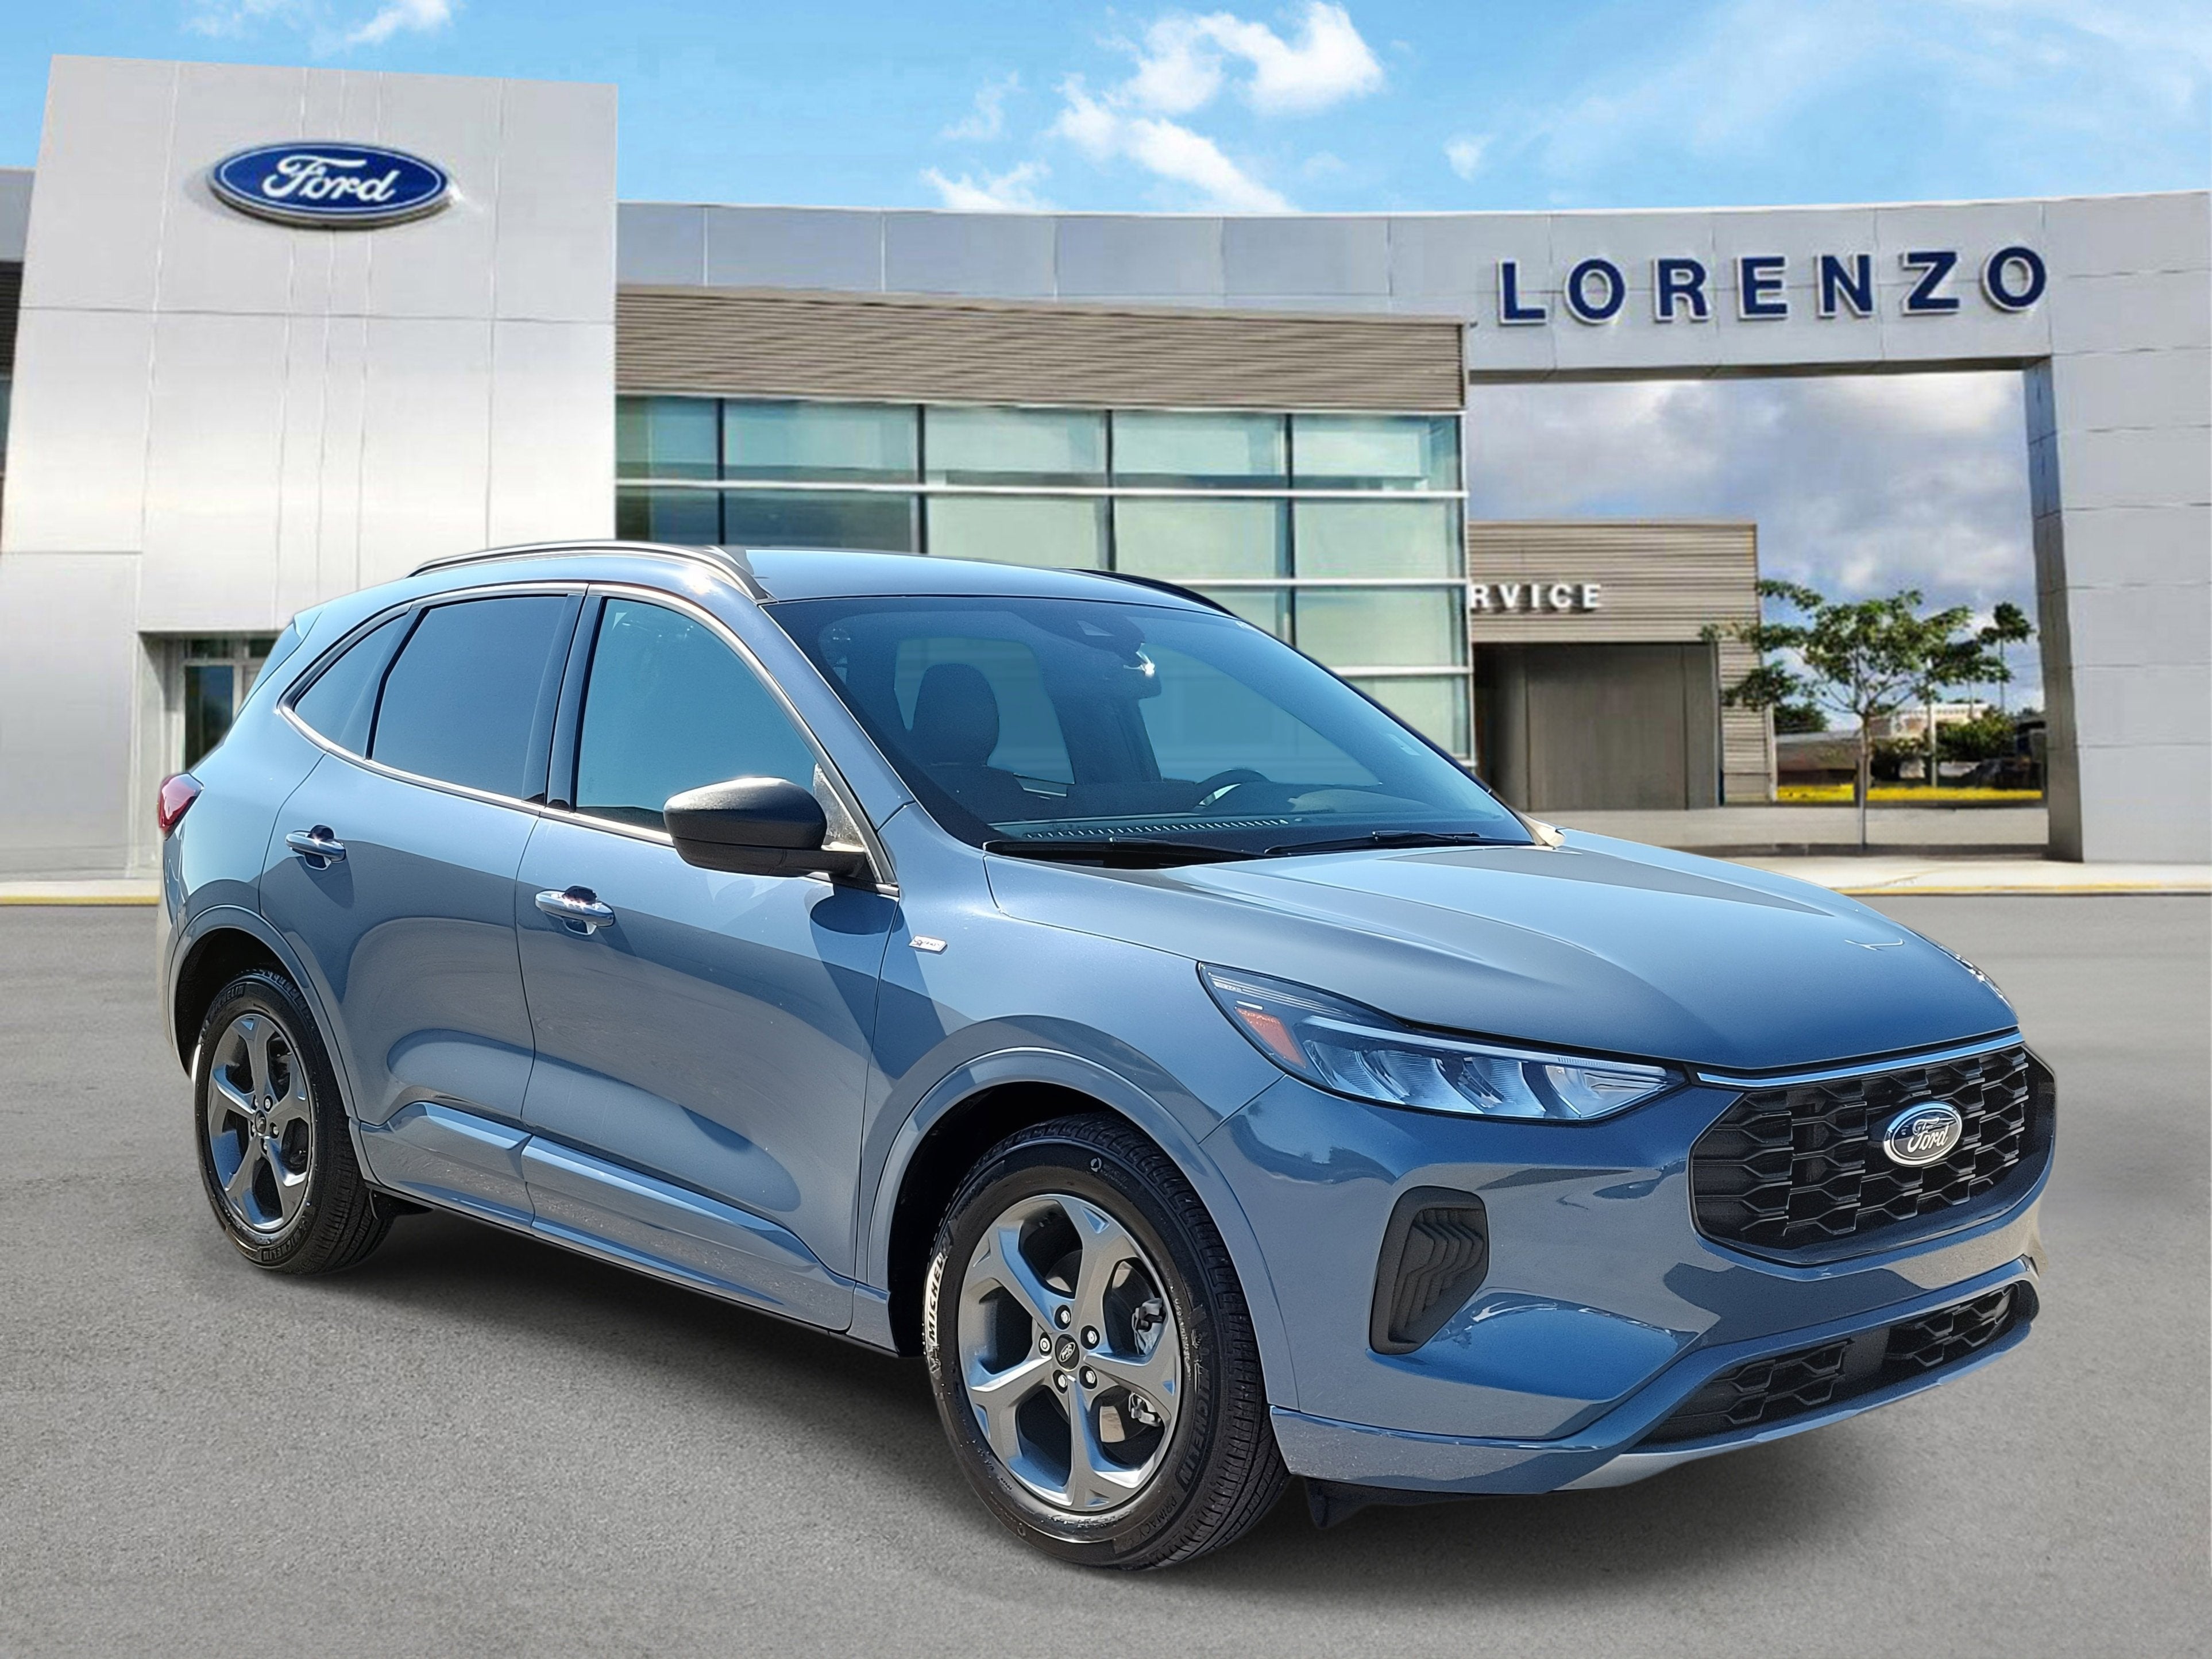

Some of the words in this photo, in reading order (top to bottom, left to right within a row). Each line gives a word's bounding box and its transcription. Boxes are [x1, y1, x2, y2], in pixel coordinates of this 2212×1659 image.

[262, 155, 400, 202] Ford
[1499, 246, 2048, 324] LORENZO
[1470, 583, 1602, 609] RVICE
[1907, 1117, 1951, 1153] Ford
[1178, 1363, 1210, 1486] MICHELIN
